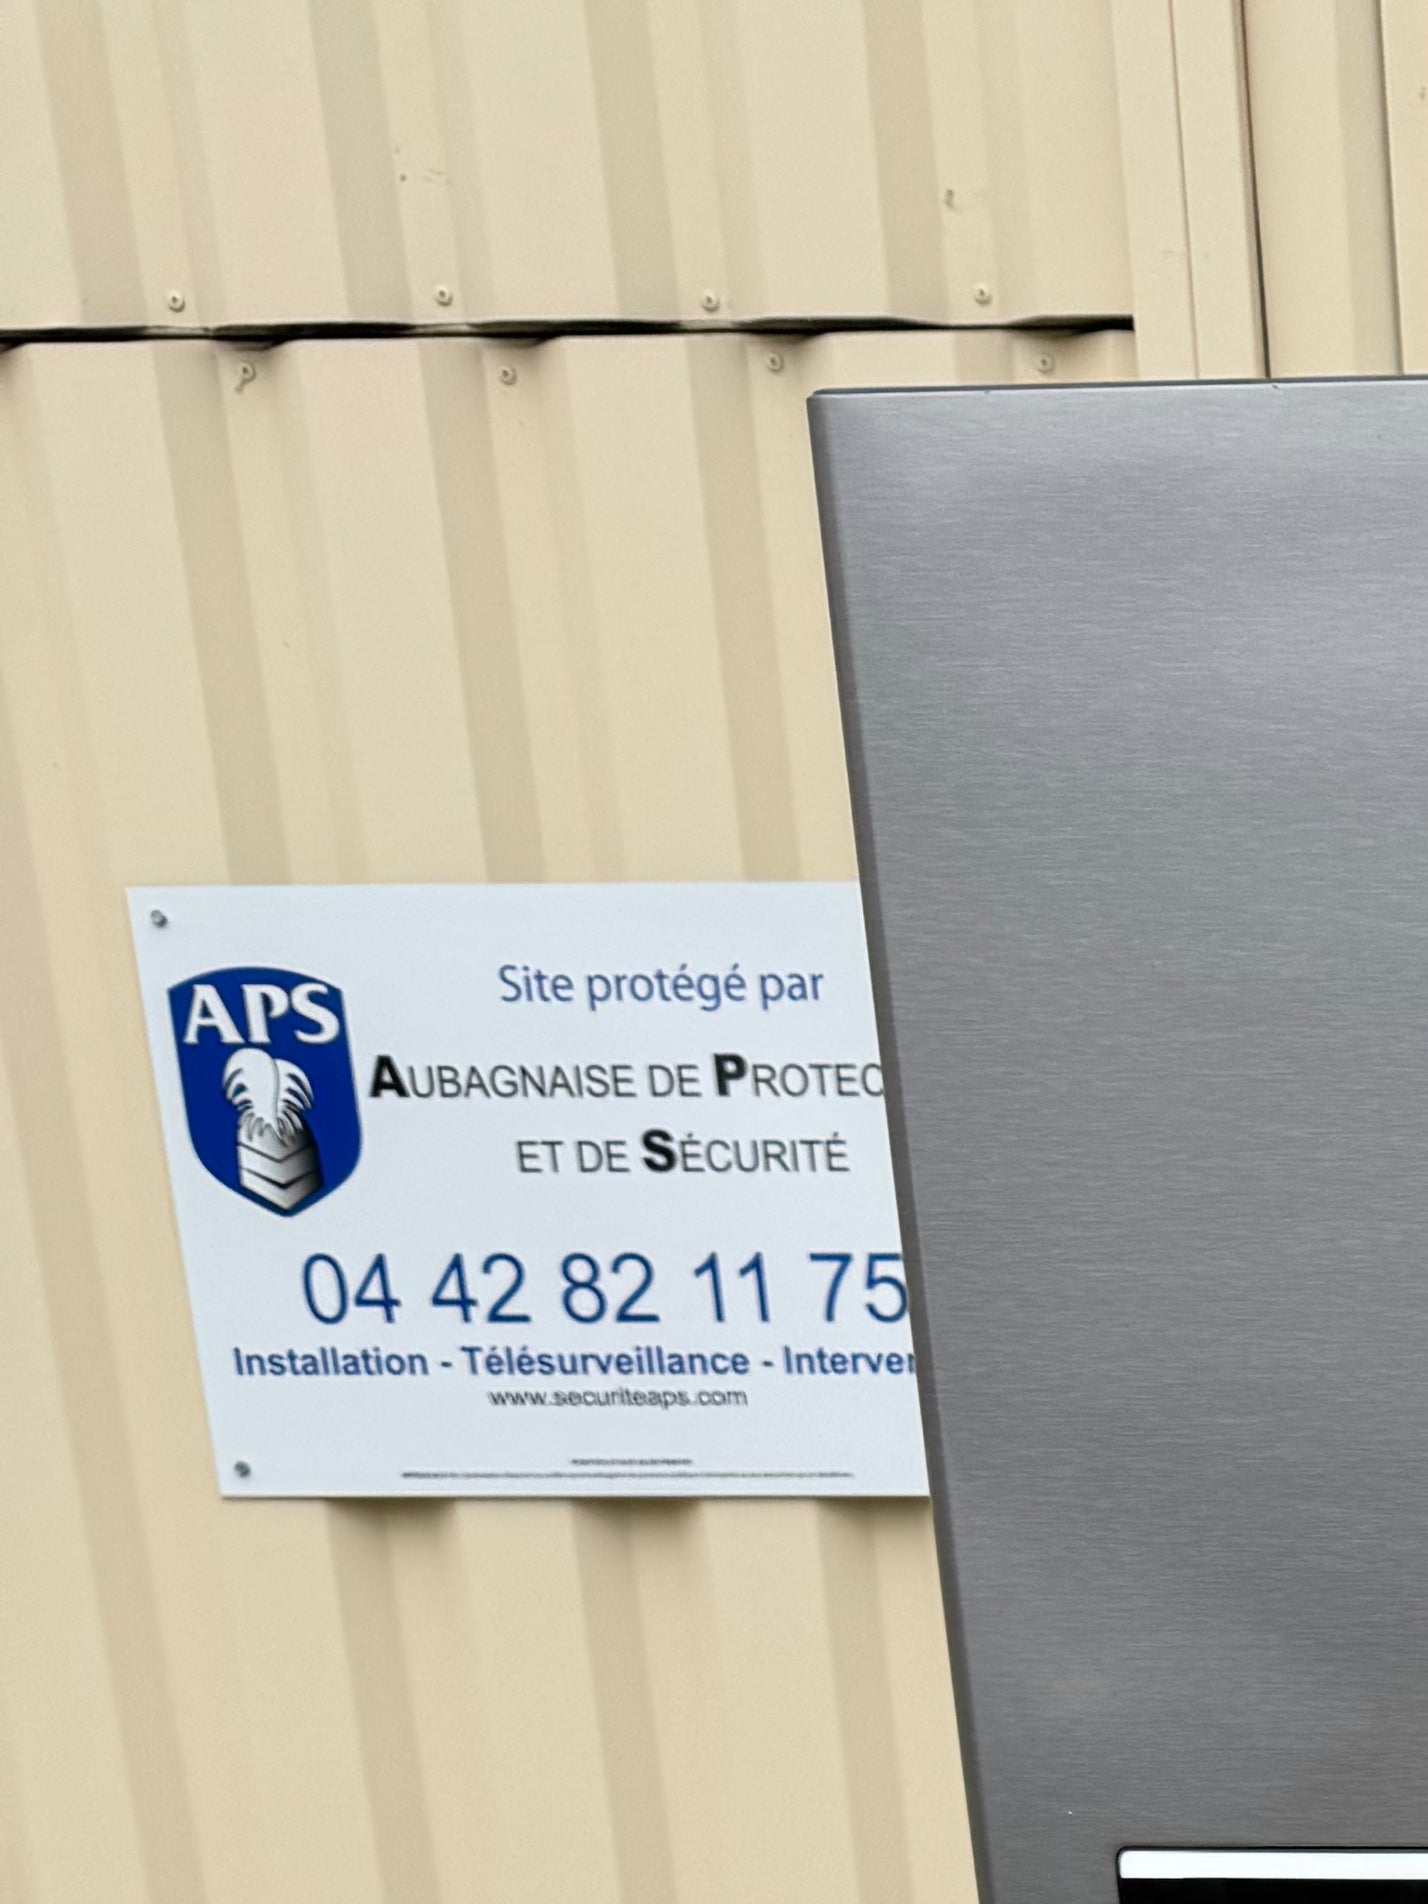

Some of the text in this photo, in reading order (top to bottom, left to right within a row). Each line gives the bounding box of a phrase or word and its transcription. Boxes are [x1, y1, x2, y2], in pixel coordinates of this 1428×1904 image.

[497, 962, 825, 1012] Site protégé par
[182, 982, 341, 1046] APS
[368, 1054, 636, 1099] AUBAGNAISE
[648, 1064, 702, 1099] DE
[516, 1128, 851, 1175] ET DE SÉCURITÉ
[302, 1251, 909, 1325] 04 42 82 11 75
[233, 1346, 430, 1377] Installation
[459, 1345, 751, 1377] Télésurveillance
[488, 1387, 748, 1411] www.securiteaps.com
